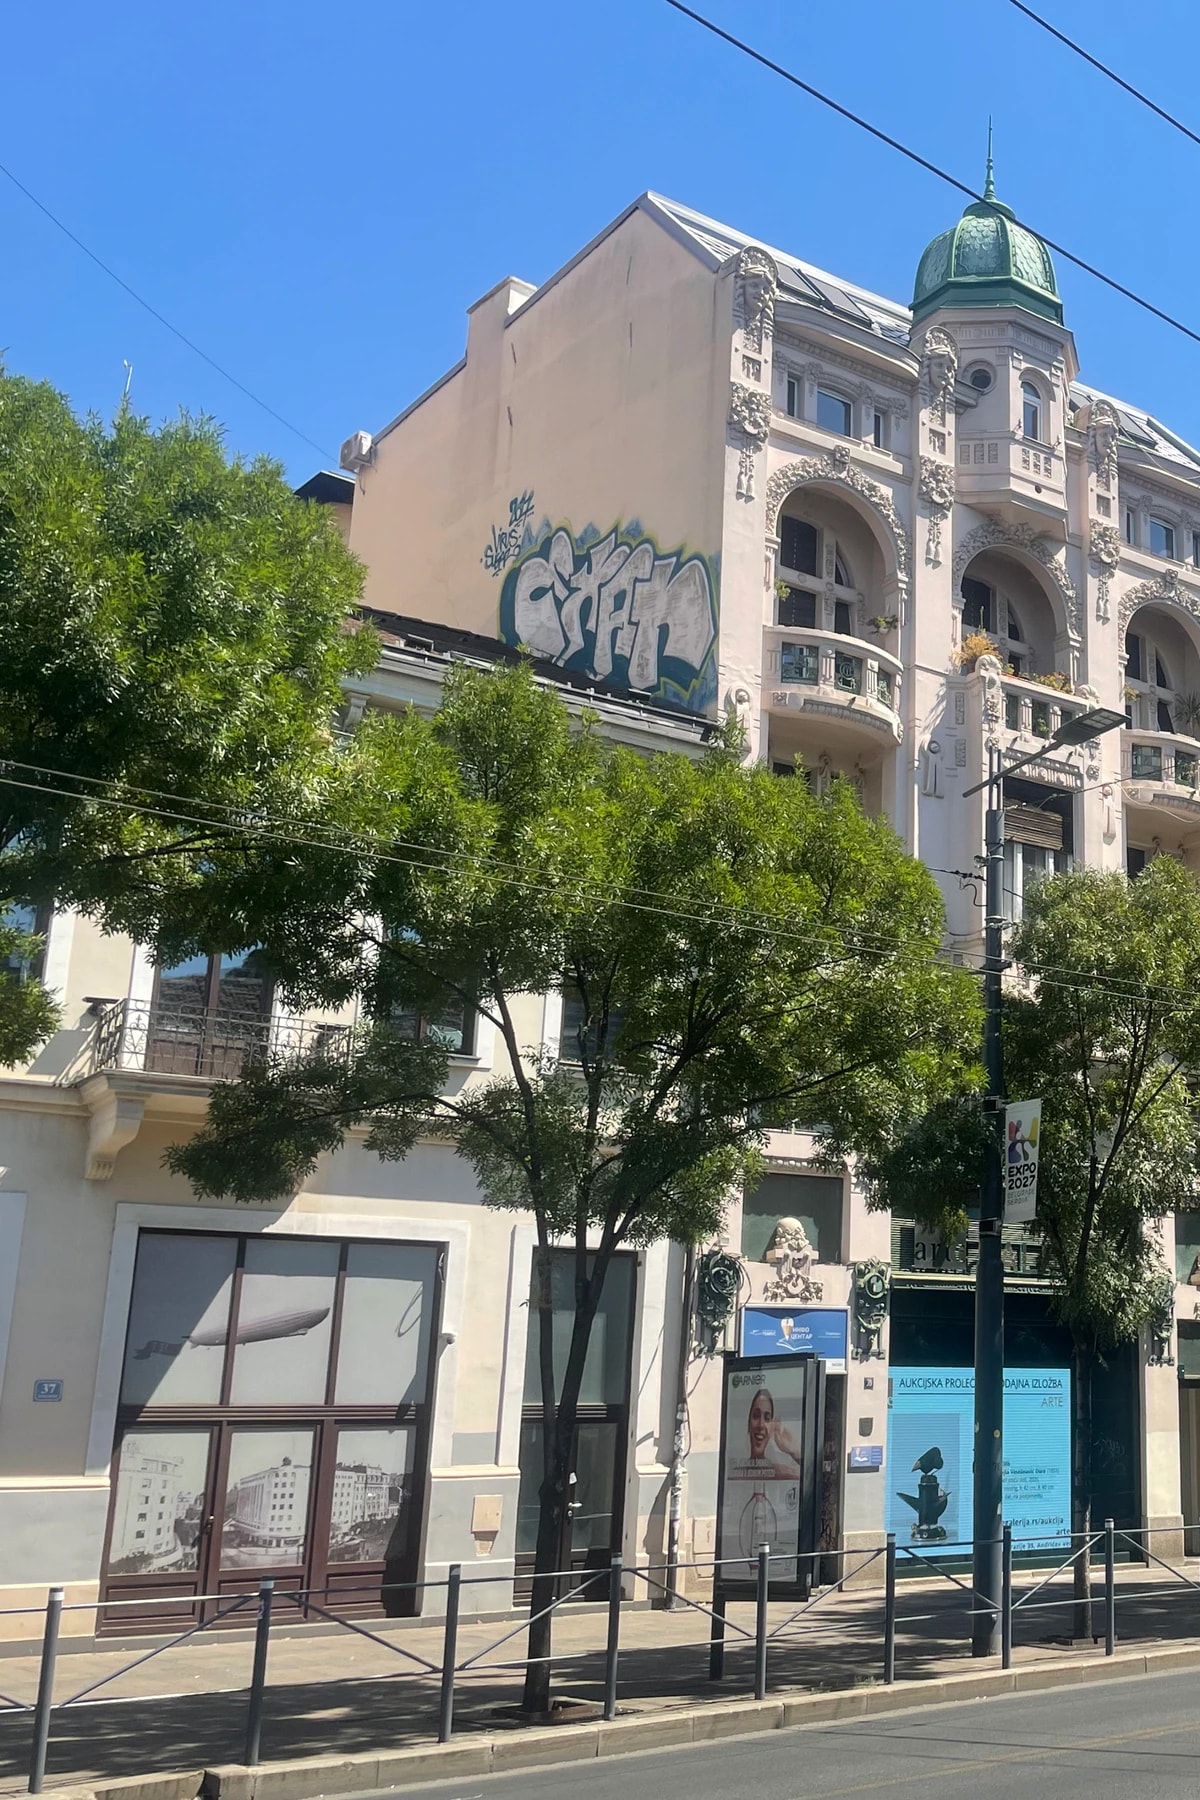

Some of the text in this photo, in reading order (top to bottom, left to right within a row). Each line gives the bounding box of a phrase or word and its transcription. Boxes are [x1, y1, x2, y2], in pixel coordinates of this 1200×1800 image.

[1008, 1162, 1037, 1178] EXPO
[1008, 1175, 1036, 1190] 2027
[40, 1383, 57, 1394] 37
[899, 1376, 1063, 1390] AUKCIJSKA PROLEĆ DAJNA IZLOŽBA
[1041, 1396, 1064, 1408] ARTE
